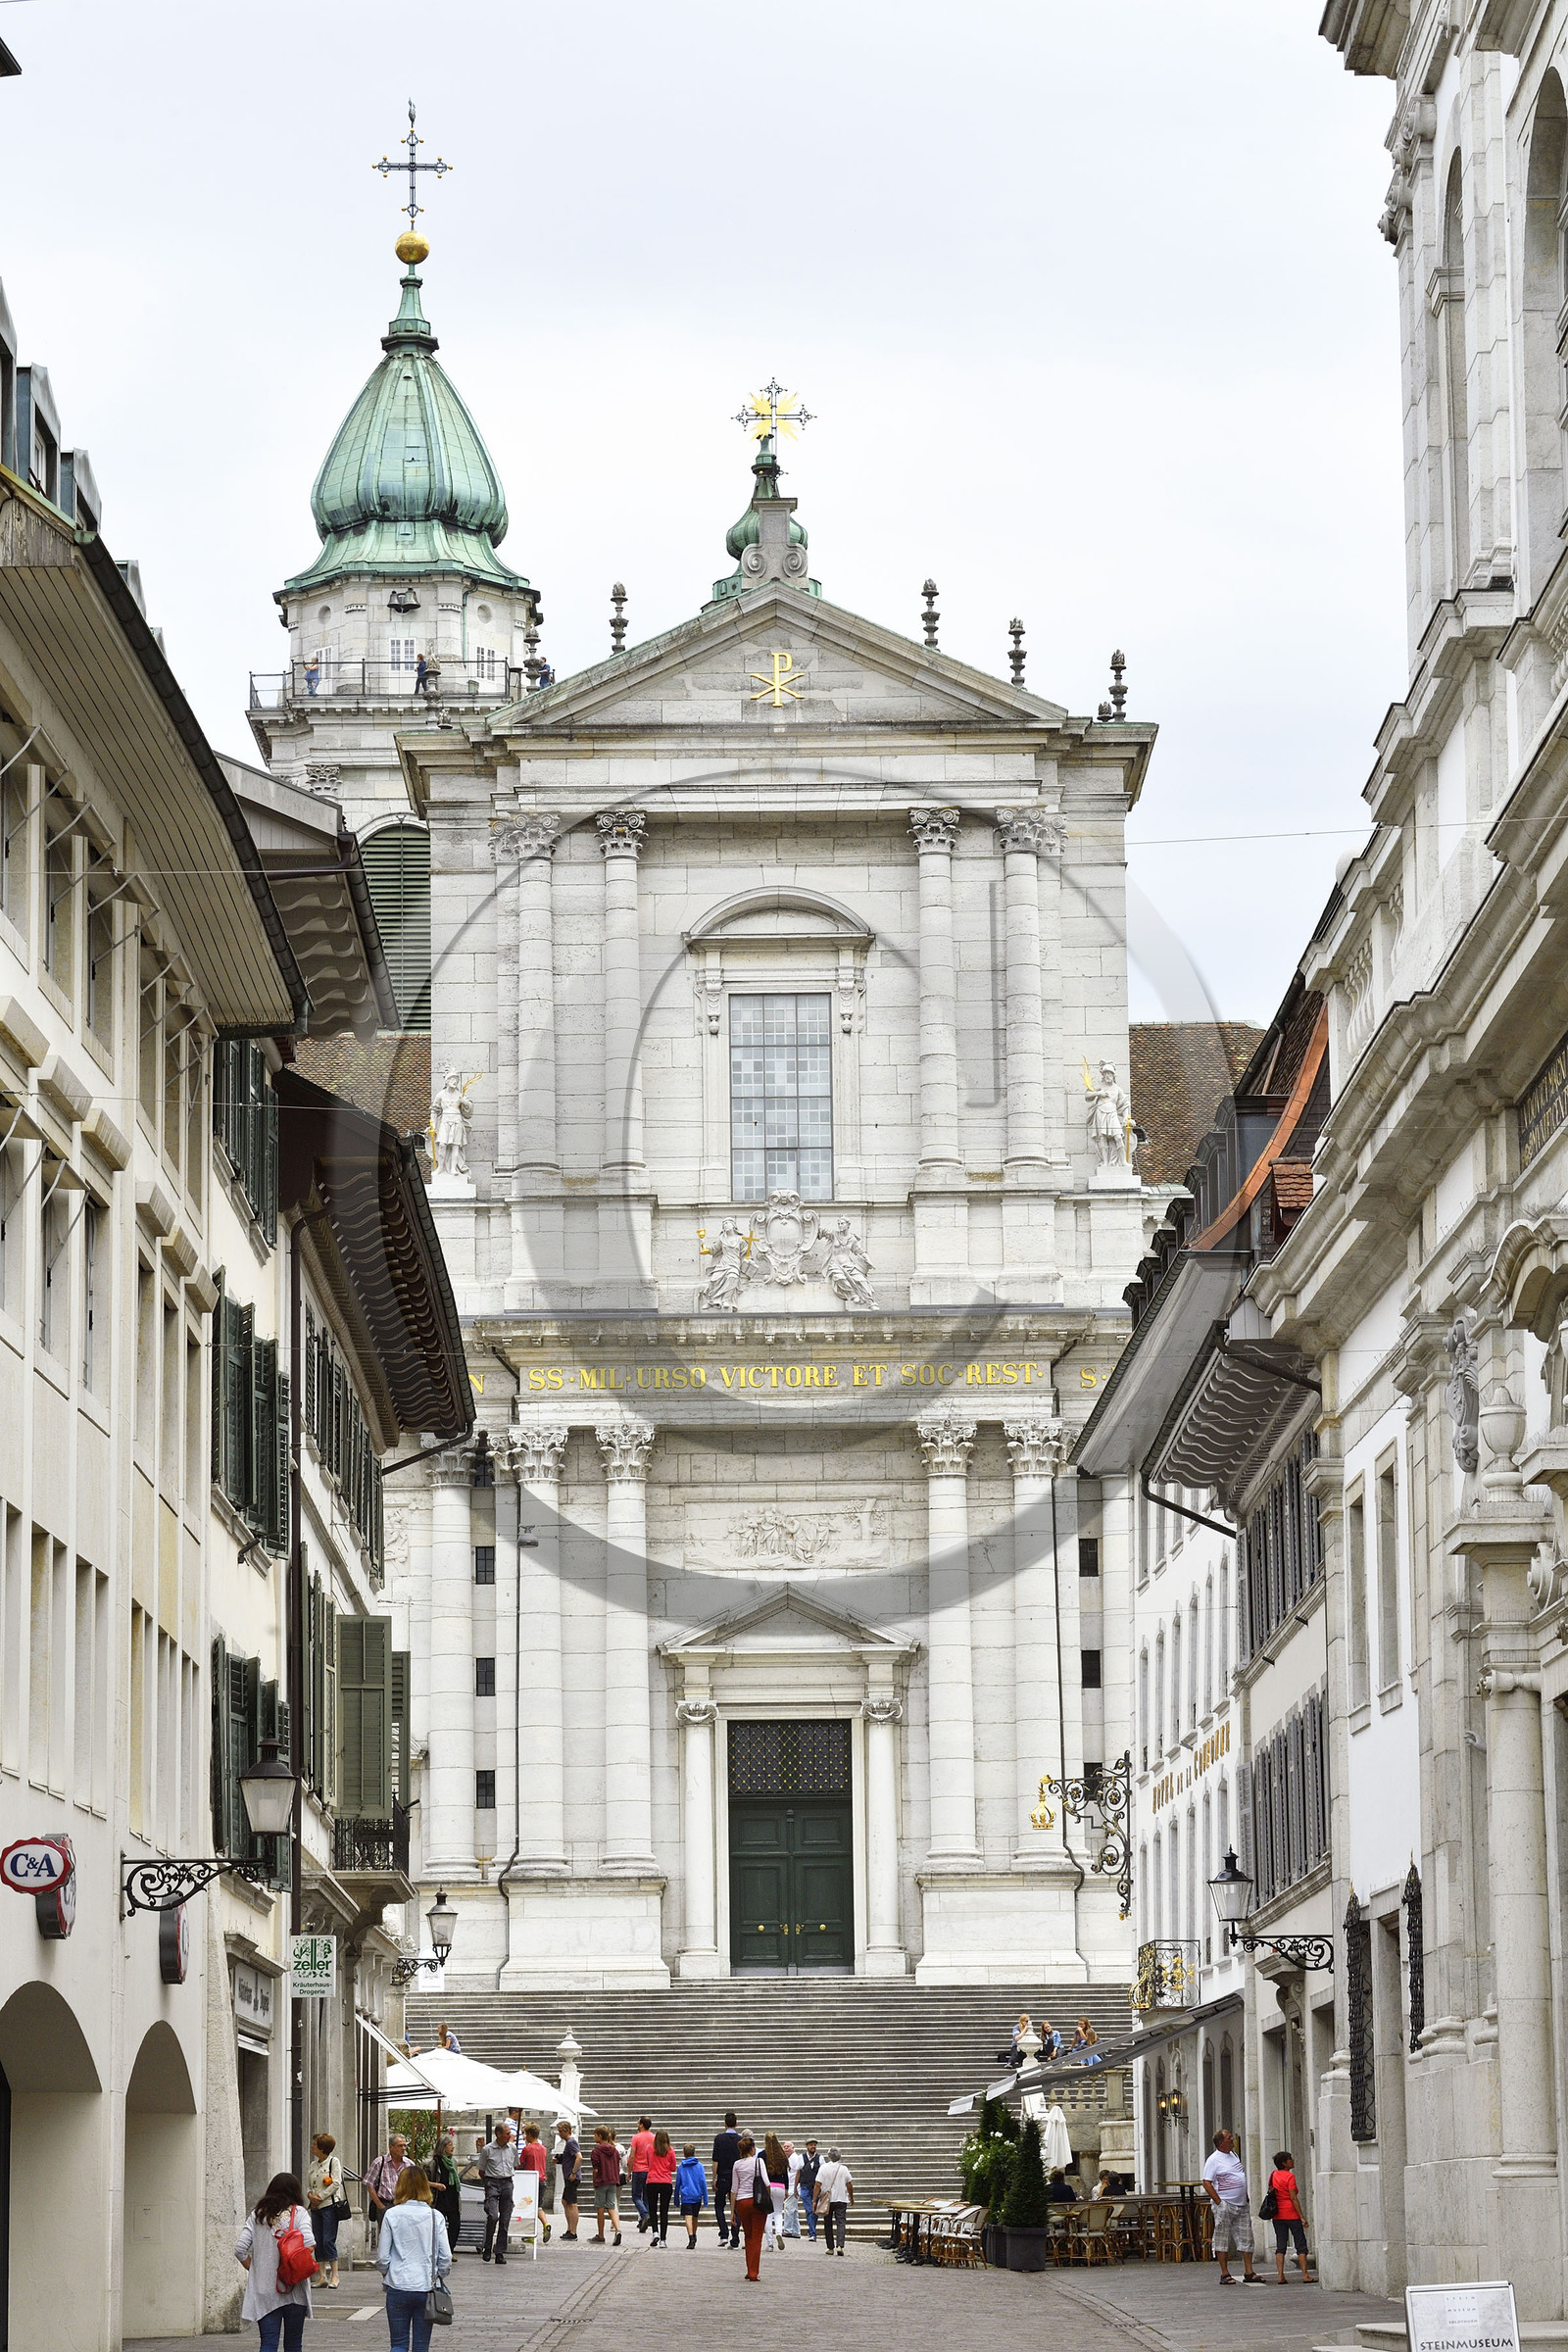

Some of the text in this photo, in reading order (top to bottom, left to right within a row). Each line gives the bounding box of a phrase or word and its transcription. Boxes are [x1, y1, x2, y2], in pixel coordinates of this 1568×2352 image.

[636, 1367, 707, 1390] URSO
[718, 1366, 838, 1389] VICTORE
[852, 1365, 888, 1387] ET
[10, 1853, 58, 1878] C&A
[1420, 2338, 1513, 2351] STEINMUSEUM
